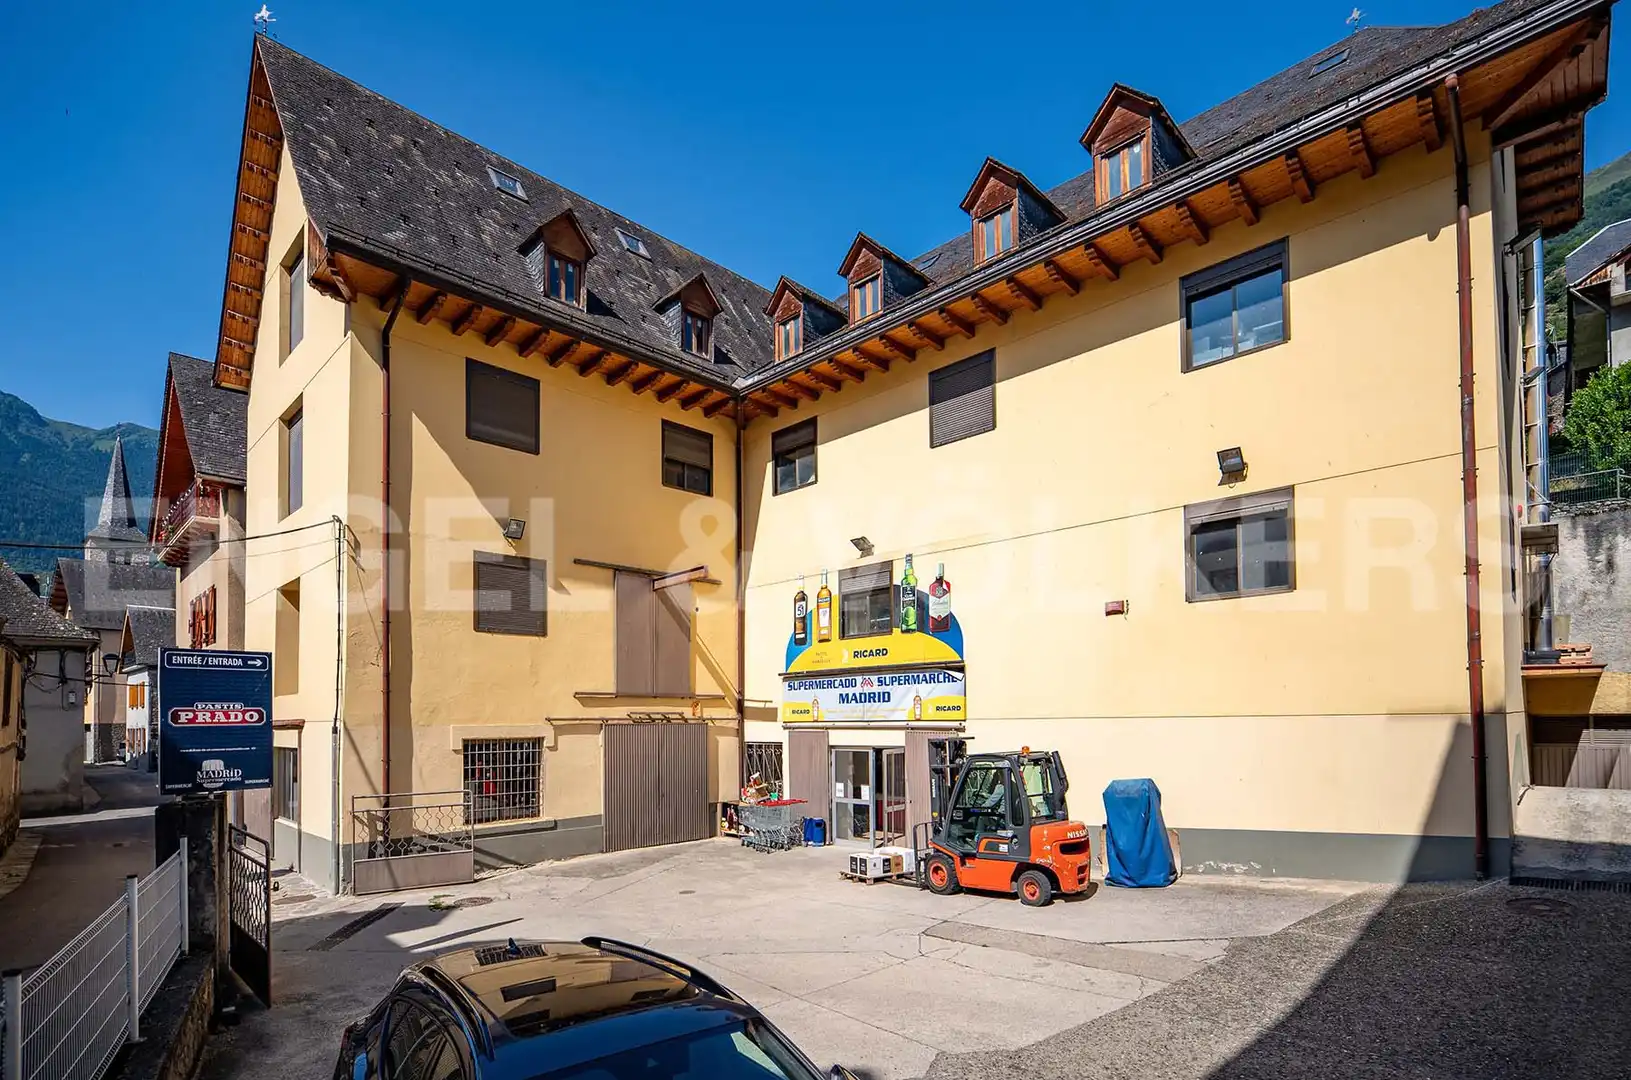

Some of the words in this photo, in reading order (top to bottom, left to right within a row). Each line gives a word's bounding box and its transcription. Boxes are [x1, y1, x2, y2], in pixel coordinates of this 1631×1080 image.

[853, 648, 888, 659] RICARD
[172, 655, 202, 665] ENTRÉE
[208, 657, 243, 667] ENTRADA
[787, 677, 857, 691] SUPERMERCADO
[838, 691, 891, 704] MADRID
[177, 711, 259, 723] PRADO
